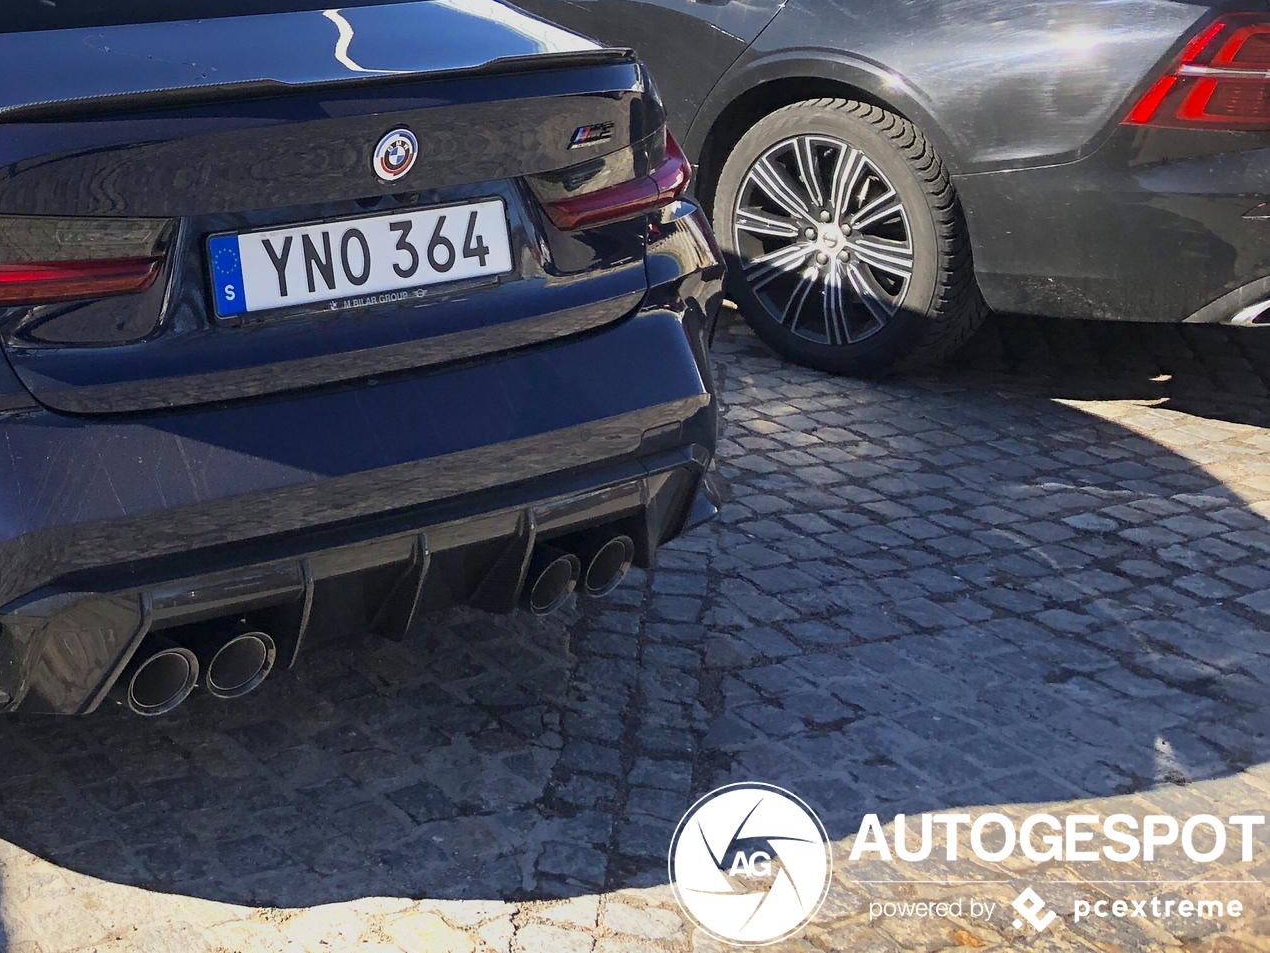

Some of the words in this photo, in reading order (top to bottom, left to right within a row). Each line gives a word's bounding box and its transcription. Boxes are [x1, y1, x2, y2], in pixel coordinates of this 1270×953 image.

[261, 228, 371, 297] YNO
[389, 211, 490, 279] 364
[224, 284, 236, 301] S
[353, 296, 378, 308] BILAR
[379, 291, 409, 303] GROUP
